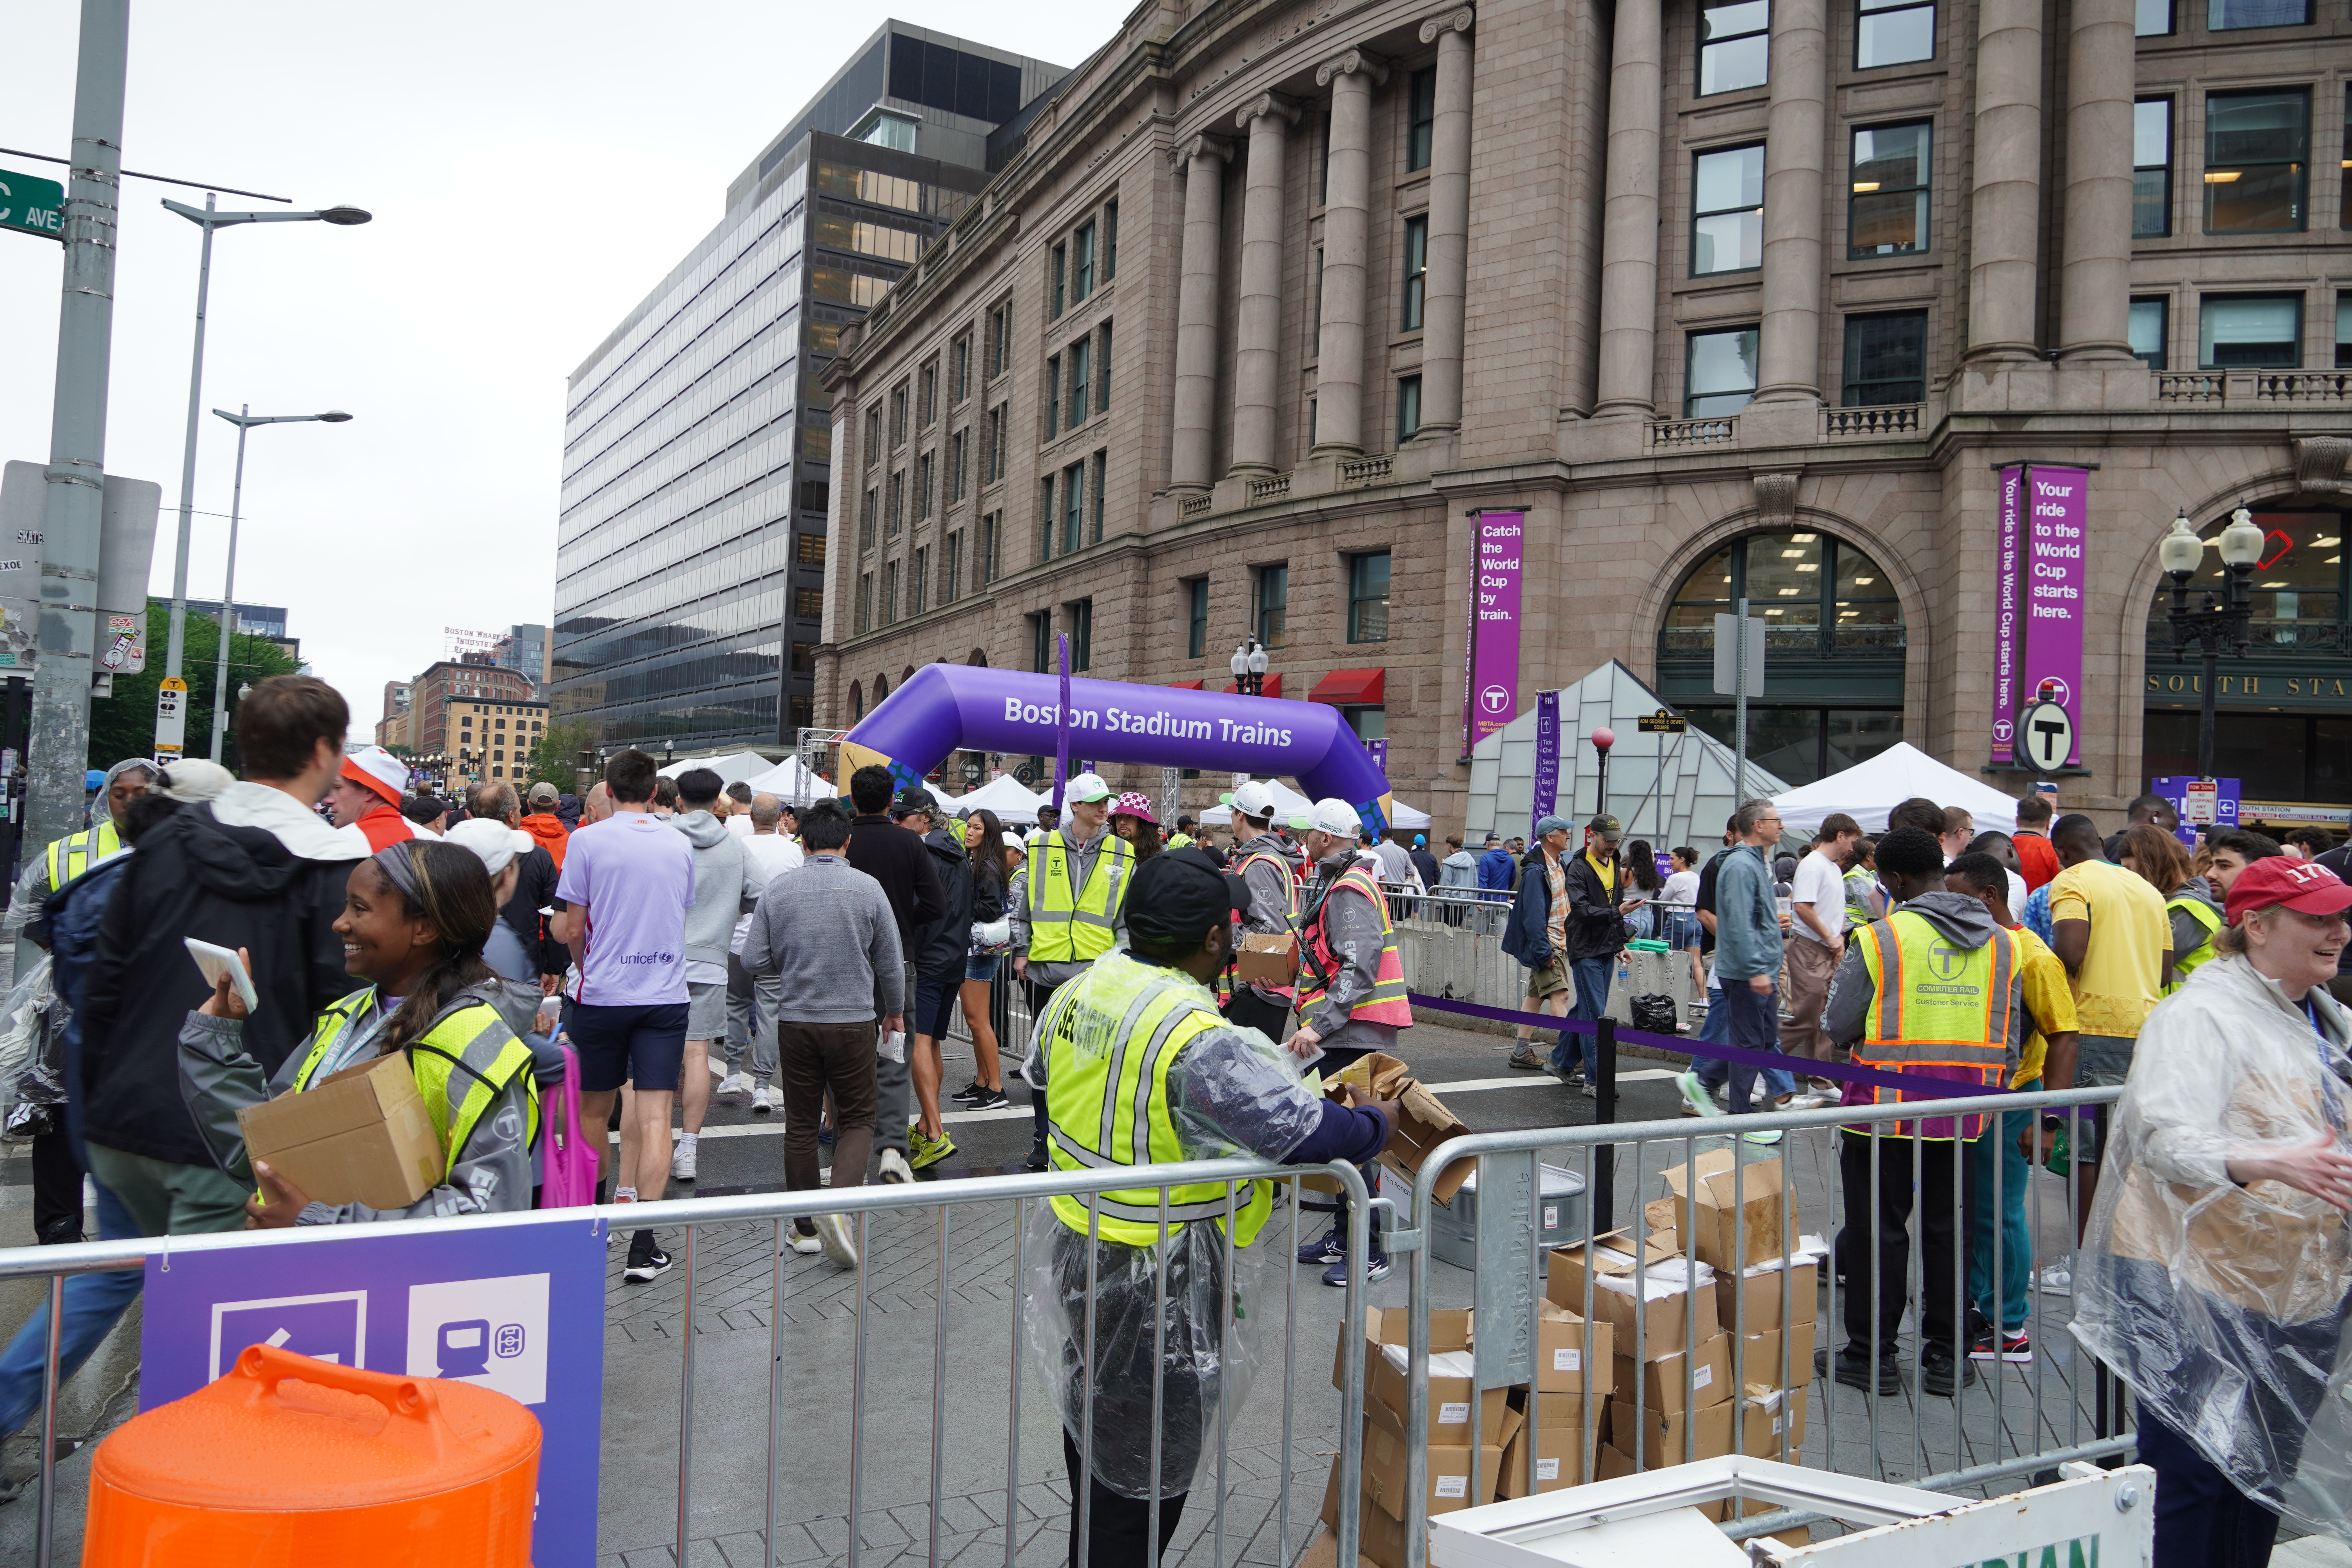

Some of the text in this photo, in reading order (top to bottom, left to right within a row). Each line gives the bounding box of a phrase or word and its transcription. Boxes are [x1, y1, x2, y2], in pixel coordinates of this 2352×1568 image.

[25, 207, 58, 230] AVE
[2036, 482, 2072, 497] Your
[2036, 503, 2065, 517] ride
[1483, 525, 1520, 537] Catch
[2035, 523, 2080, 538] to the
[1482, 543, 1503, 553] the
[2035, 542, 2080, 558] World
[1481, 558, 1519, 570] World
[2034, 563, 2066, 580] Cup
[1481, 575, 1507, 589] Cup
[2000, 477, 2016, 709] Your ride to the World Cup starts here.
[2034, 584, 2078, 599] starts
[1480, 592, 1496, 606] by
[1479, 609, 1512, 620] train.
[2033, 603, 2072, 619] here.
[445, 627, 473, 636] BOSTON
[477, 631, 501, 639] WHARF
[457, 637, 500, 648] INDUSTRIAL
[454, 646, 504, 658] REAL ESTATE
[1465, 658, 1470, 672] by
[2148, 674, 2345, 696] SOUTH STA
[1486, 692, 1504, 708] T
[1004, 697, 1292, 747] Boston Stadium Trains
[1996, 724, 2010, 738] T
[2034, 720, 2064, 761] T
[1022, 771, 1031, 783] 2
[1236, 802, 1249, 812] BOSTON
[1319, 824, 1338, 833] BOSTON
[621, 951, 658, 964] unicef
[1934, 948, 1960, 974] T
[1915, 998, 1980, 1007] Customer Service
[1384, 1173, 1394, 1186] Rain
[1508, 1173, 1529, 1366] Boston Police
